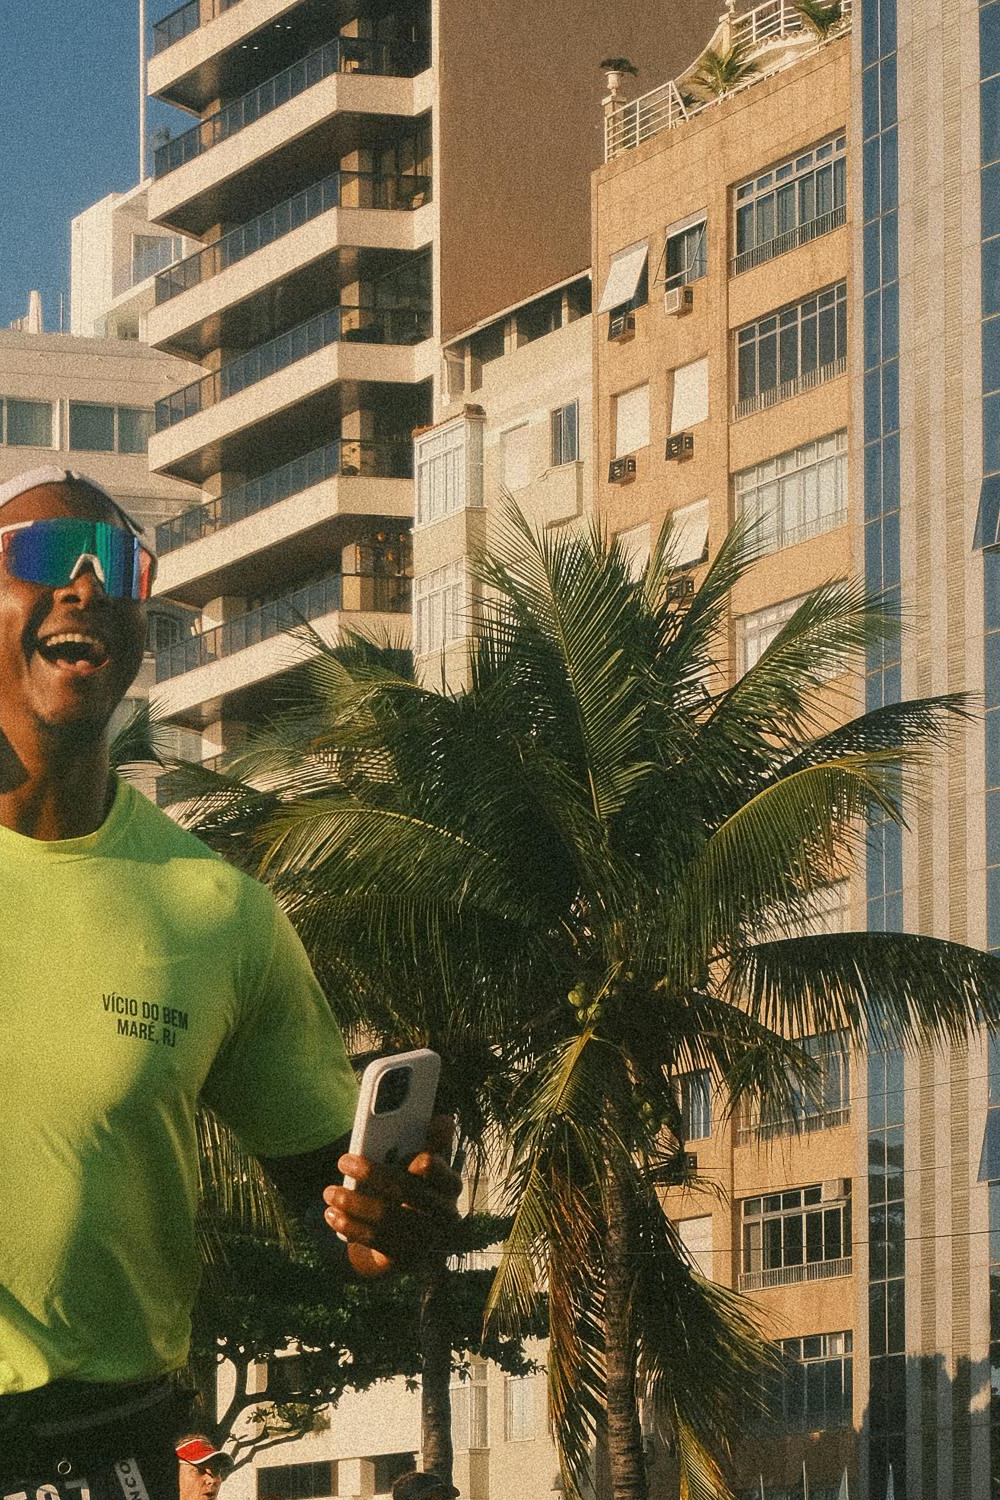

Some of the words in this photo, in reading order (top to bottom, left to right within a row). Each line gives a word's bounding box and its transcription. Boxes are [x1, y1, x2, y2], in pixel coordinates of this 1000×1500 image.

[102, 992, 138, 1016] VÍCIO
[142, 1001, 159, 1021] DO
[163, 1006, 189, 1030] BEM
[163, 1028, 176, 1048] RJ
